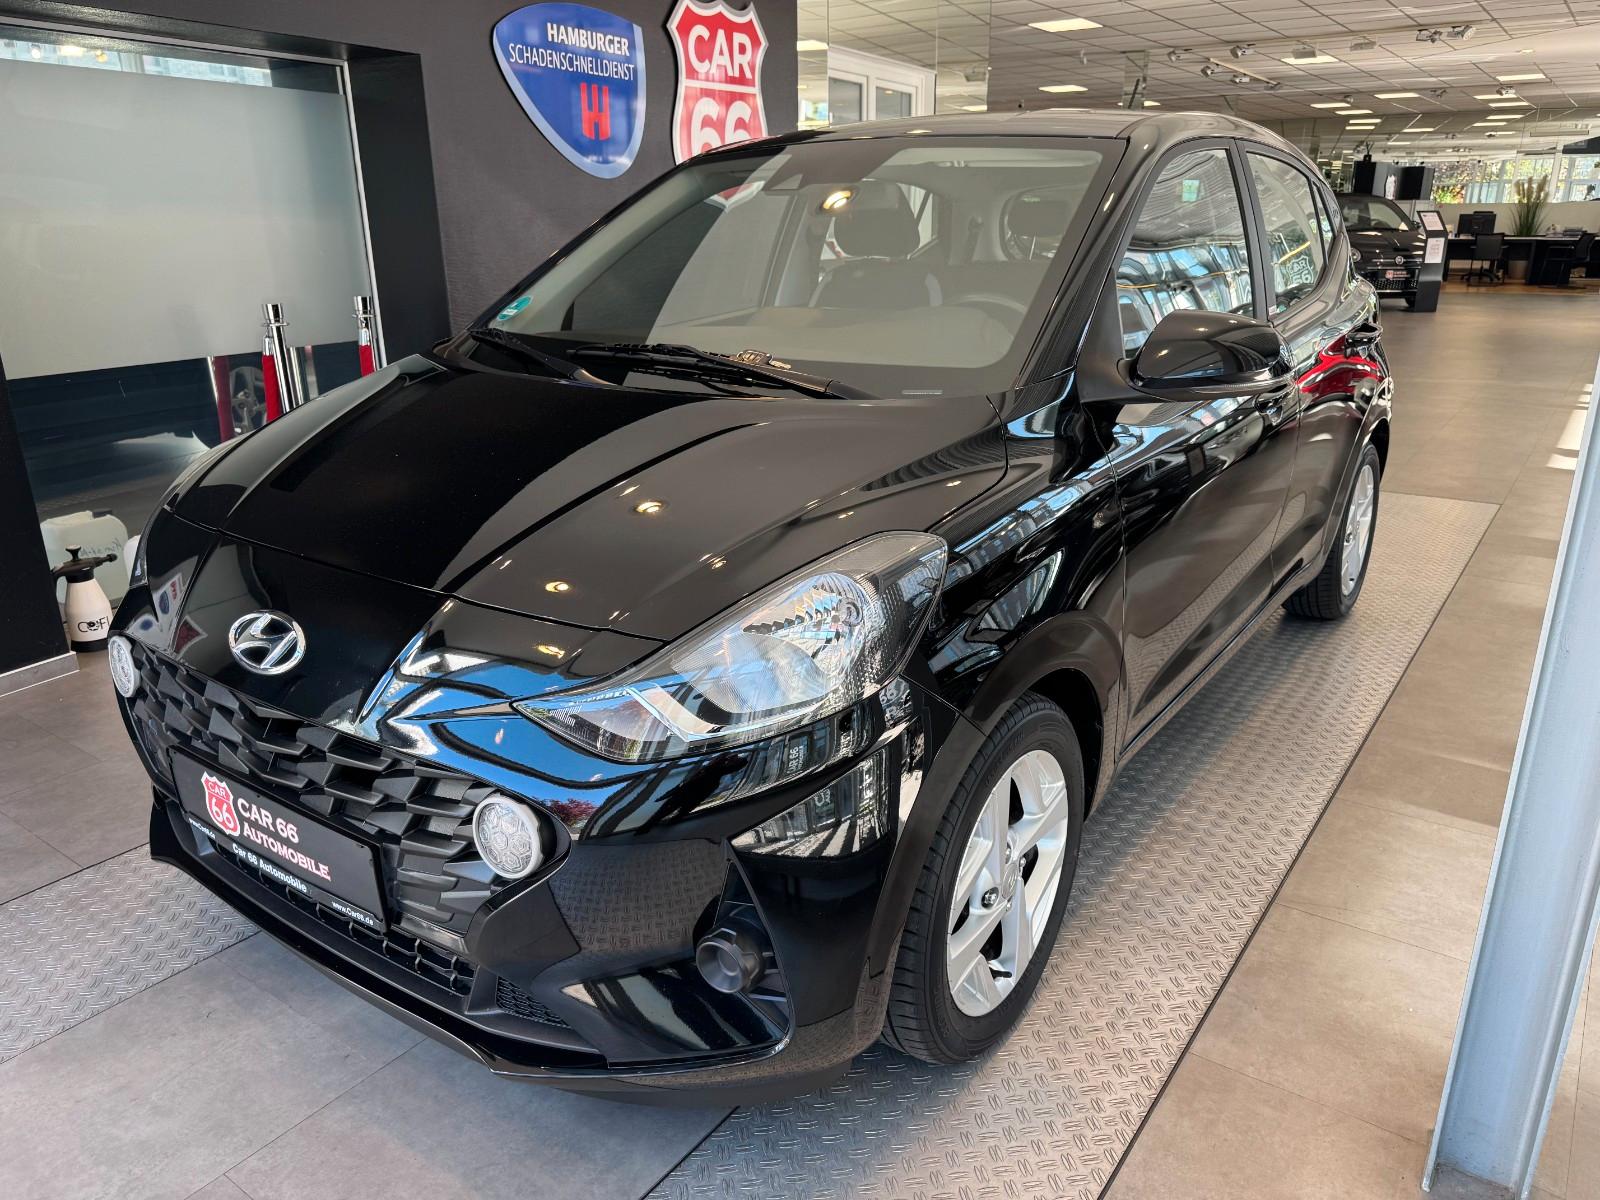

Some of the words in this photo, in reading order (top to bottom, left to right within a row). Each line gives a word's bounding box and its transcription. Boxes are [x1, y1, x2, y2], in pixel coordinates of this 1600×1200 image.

[547, 22, 630, 56] HAMBURGER
[687, 24, 752, 79] CAR
[508, 43, 635, 81] SCHADENSCHNELLDIENST
[208, 781, 227, 798] CAR
[211, 798, 235, 829] 66
[237, 798, 275, 832] CAR
[276, 818, 300, 843] 66
[232, 843, 246, 860] Car
[248, 852, 258, 865] 66
[259, 858, 308, 893] Automobile
[243, 823, 331, 881] AUTOMOBILE
